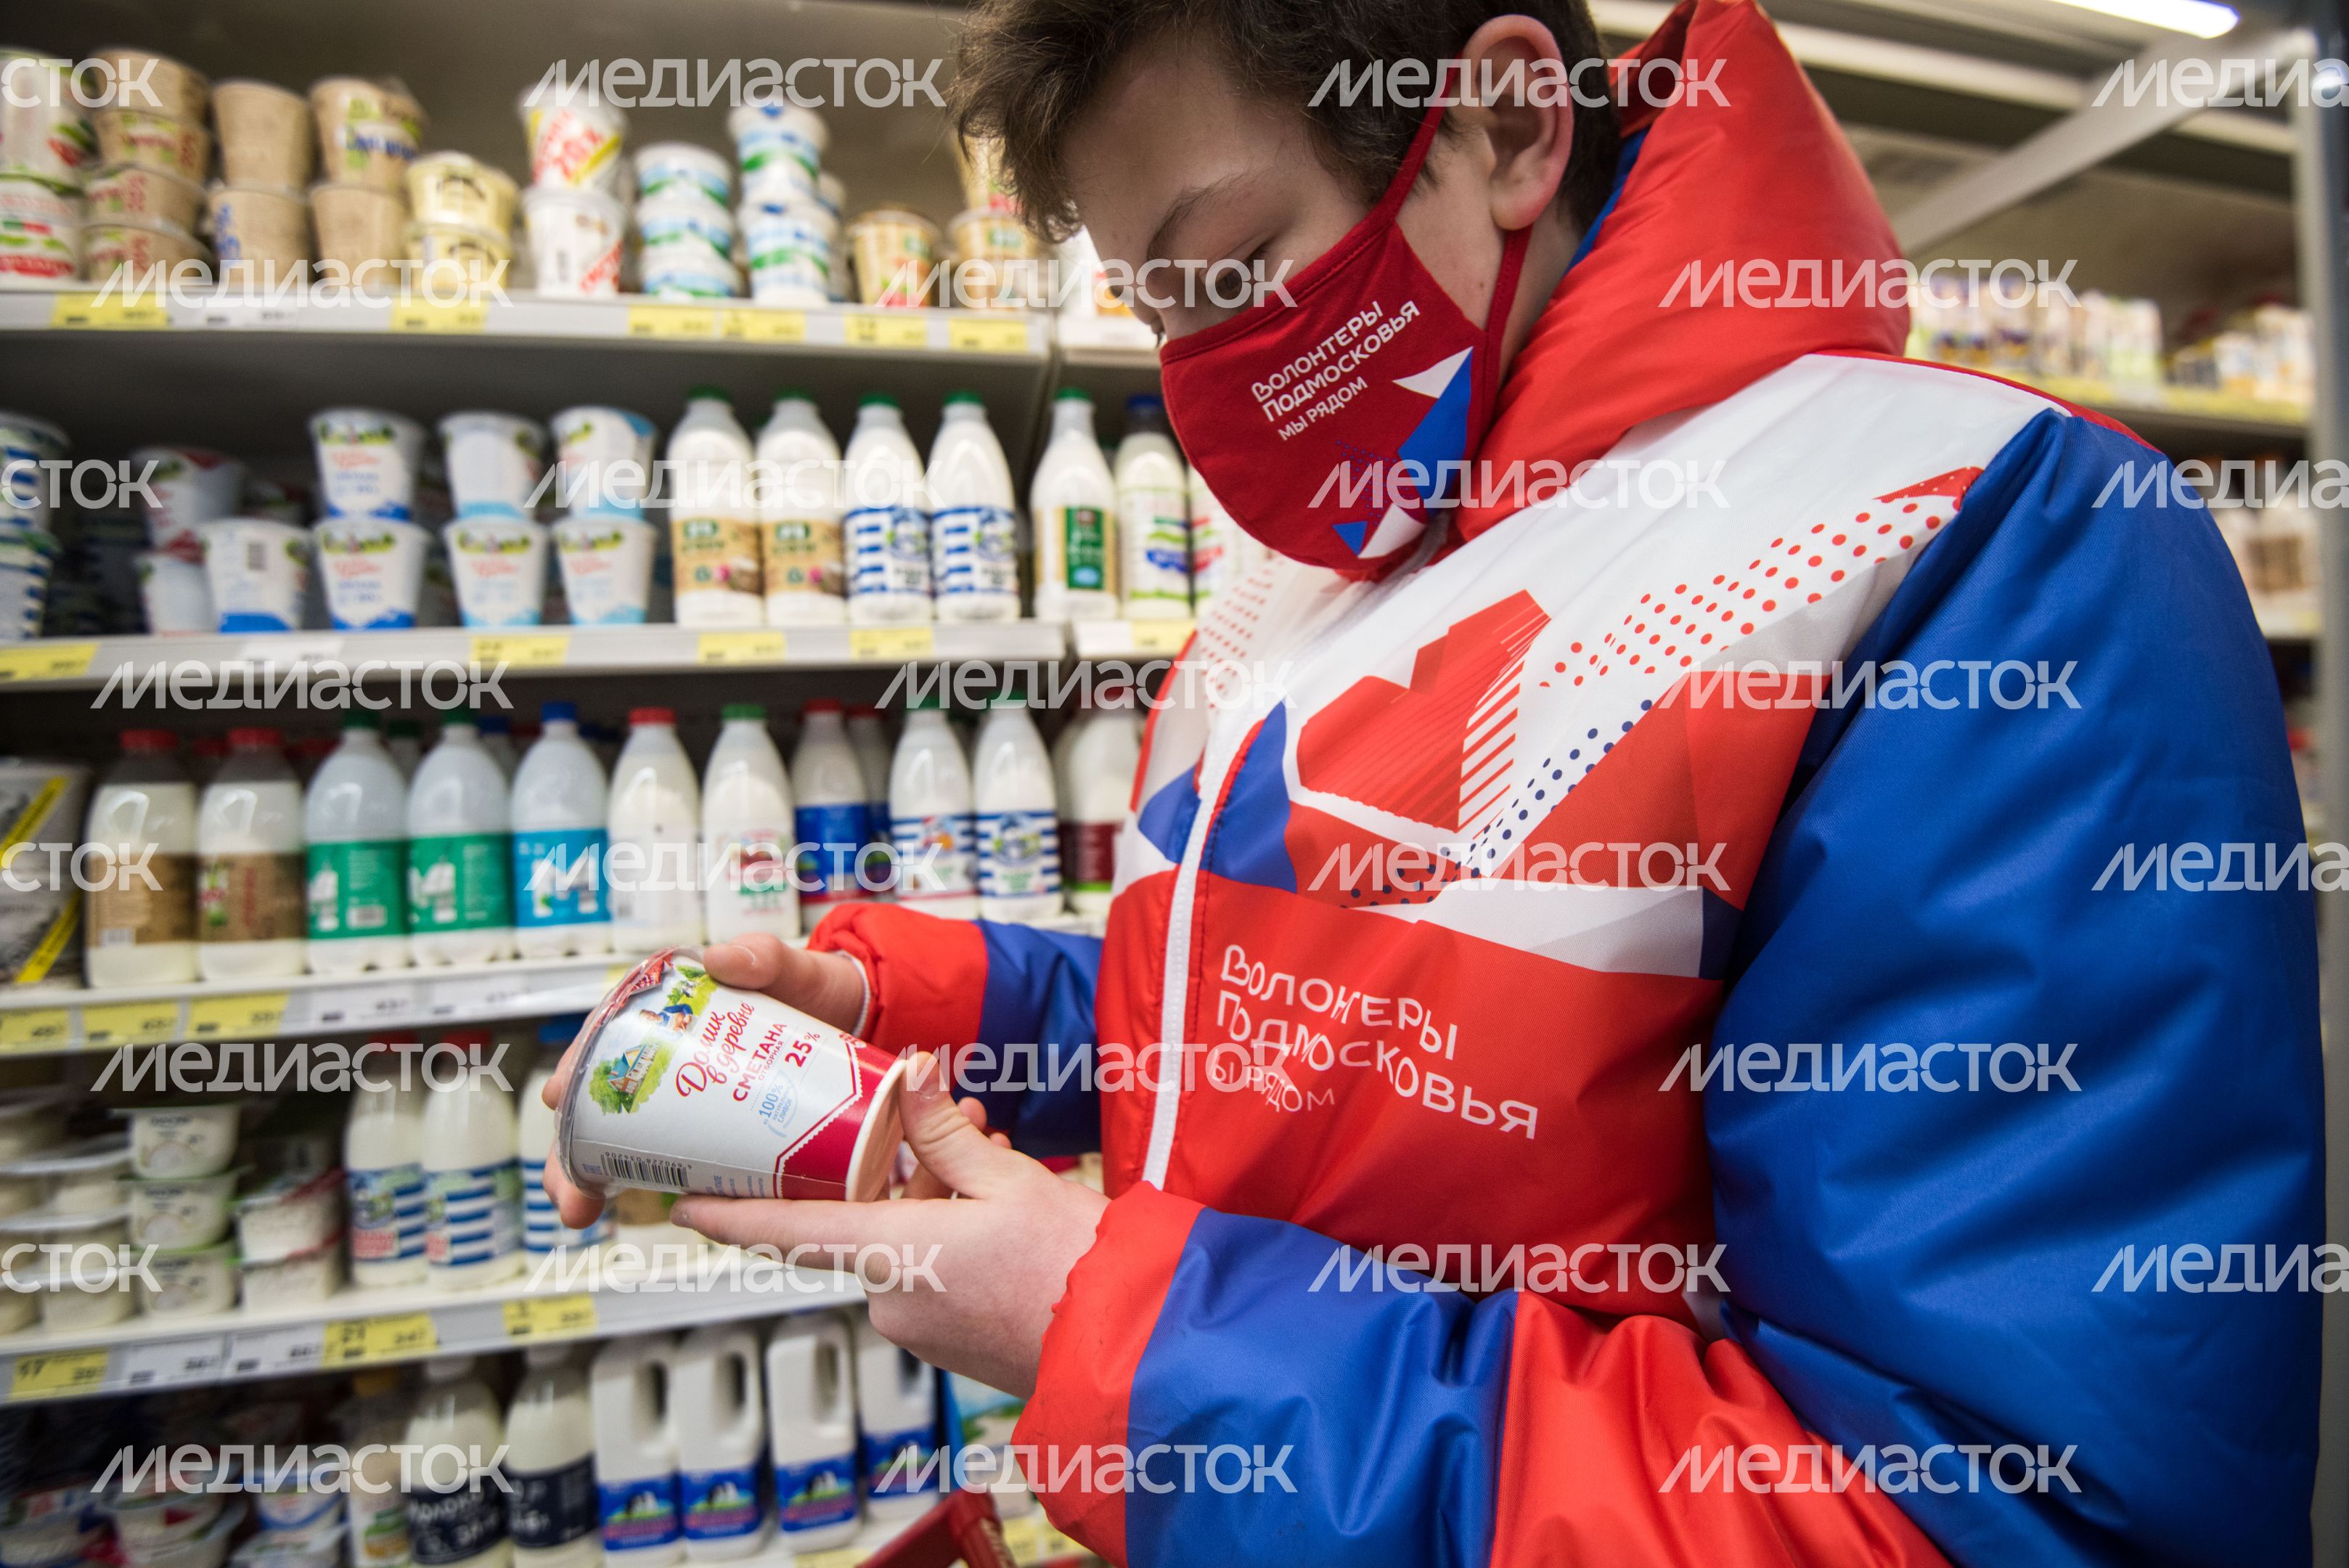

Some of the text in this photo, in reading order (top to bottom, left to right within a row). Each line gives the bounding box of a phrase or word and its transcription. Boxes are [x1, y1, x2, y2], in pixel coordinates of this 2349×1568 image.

[1251, 301, 1384, 402] ВОЛОНТЕРЫ
[1262, 300, 1420, 422] ПОДМОСКОВЬЯ
[1278, 376, 1368, 441] МЫ РЯДОМ
[732, 1023, 788, 1101] СМЕТАНА
[758, 1040, 785, 1080] ОТБОРНАЯ
[759, 1084, 784, 1119] 100%
